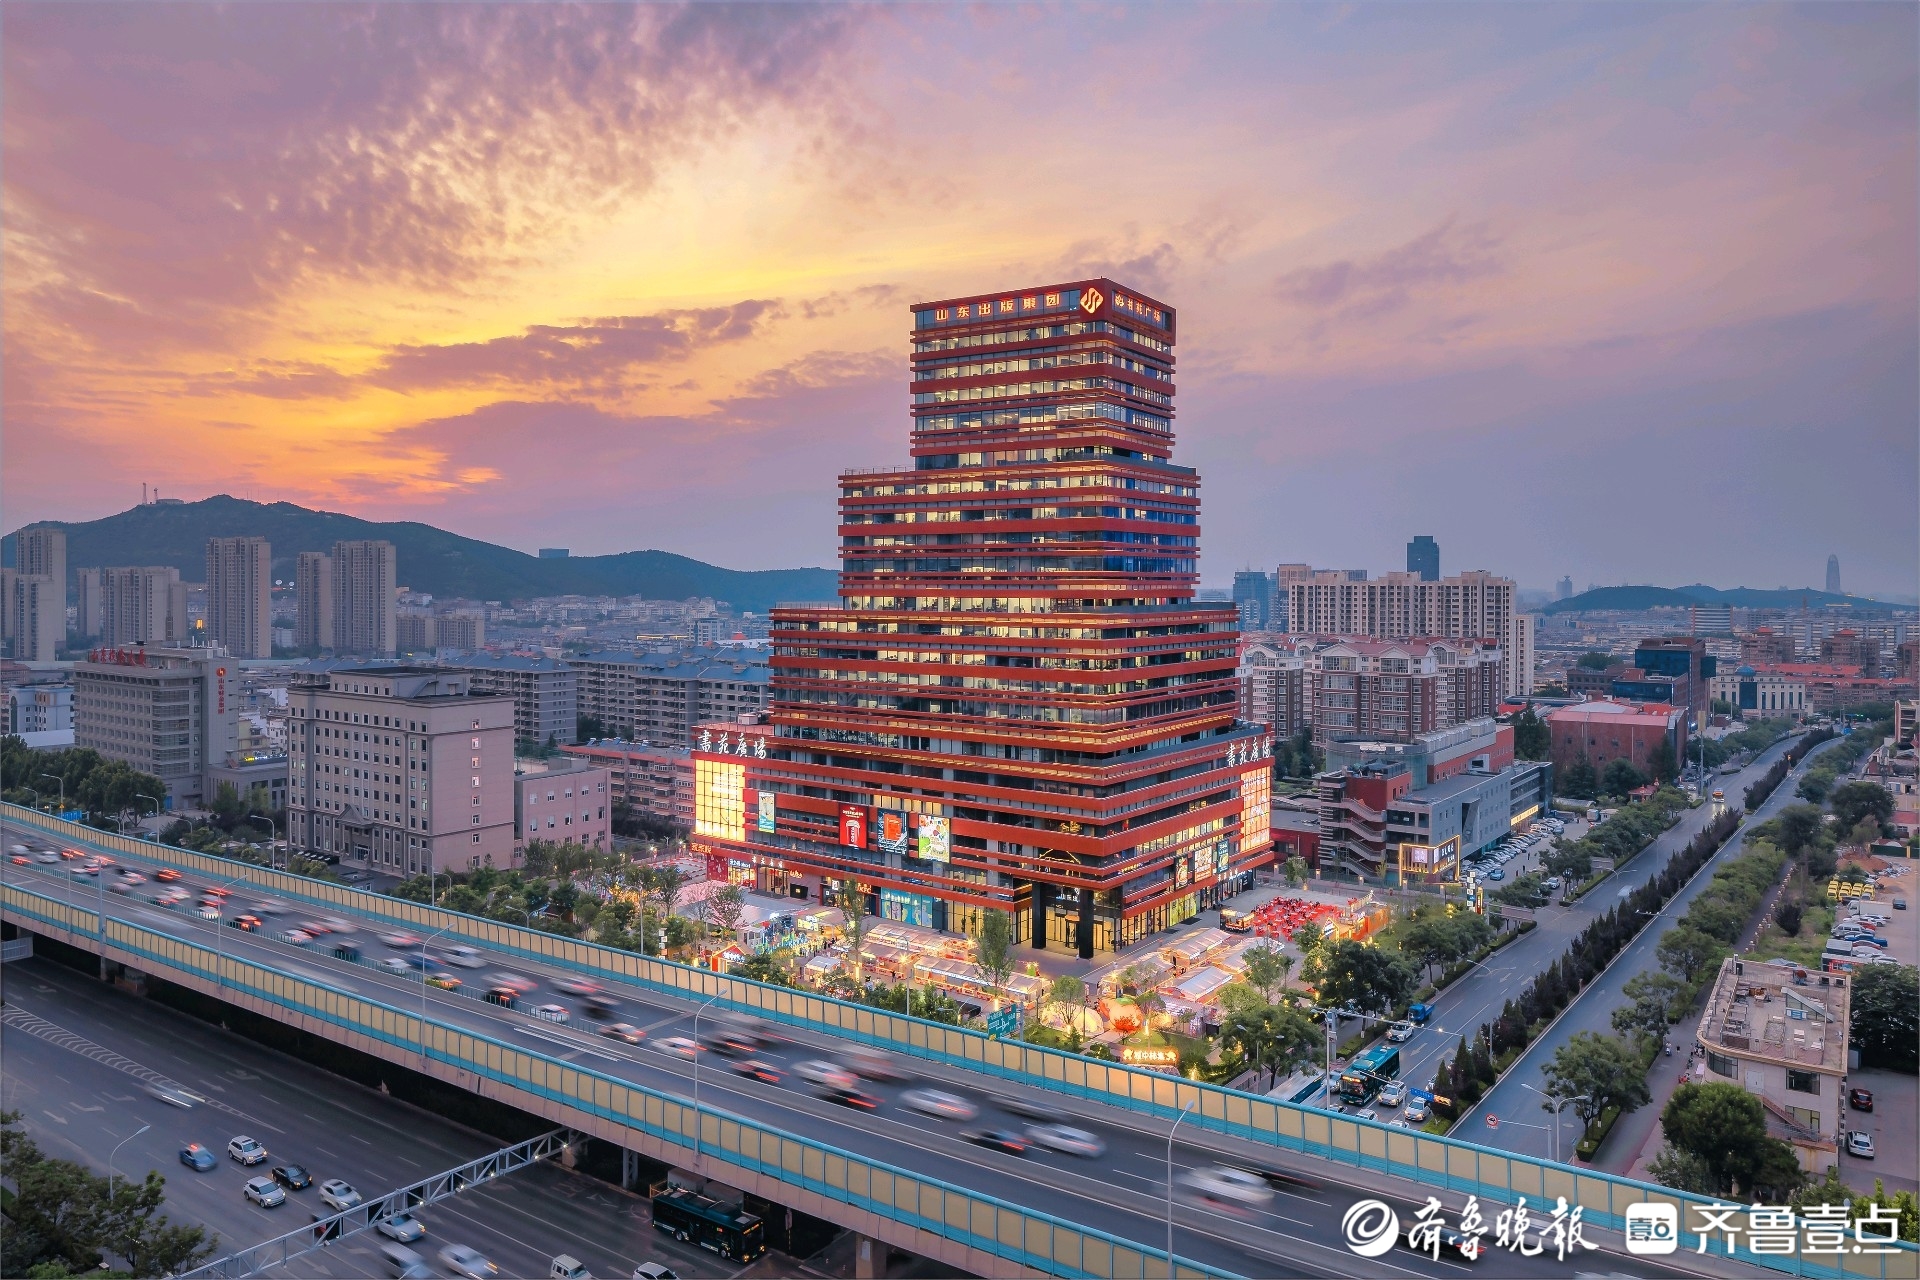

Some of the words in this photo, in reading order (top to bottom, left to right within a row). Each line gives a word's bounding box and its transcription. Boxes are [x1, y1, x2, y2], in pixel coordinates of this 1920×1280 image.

[936, 293, 1060, 321] 山东出版集团
